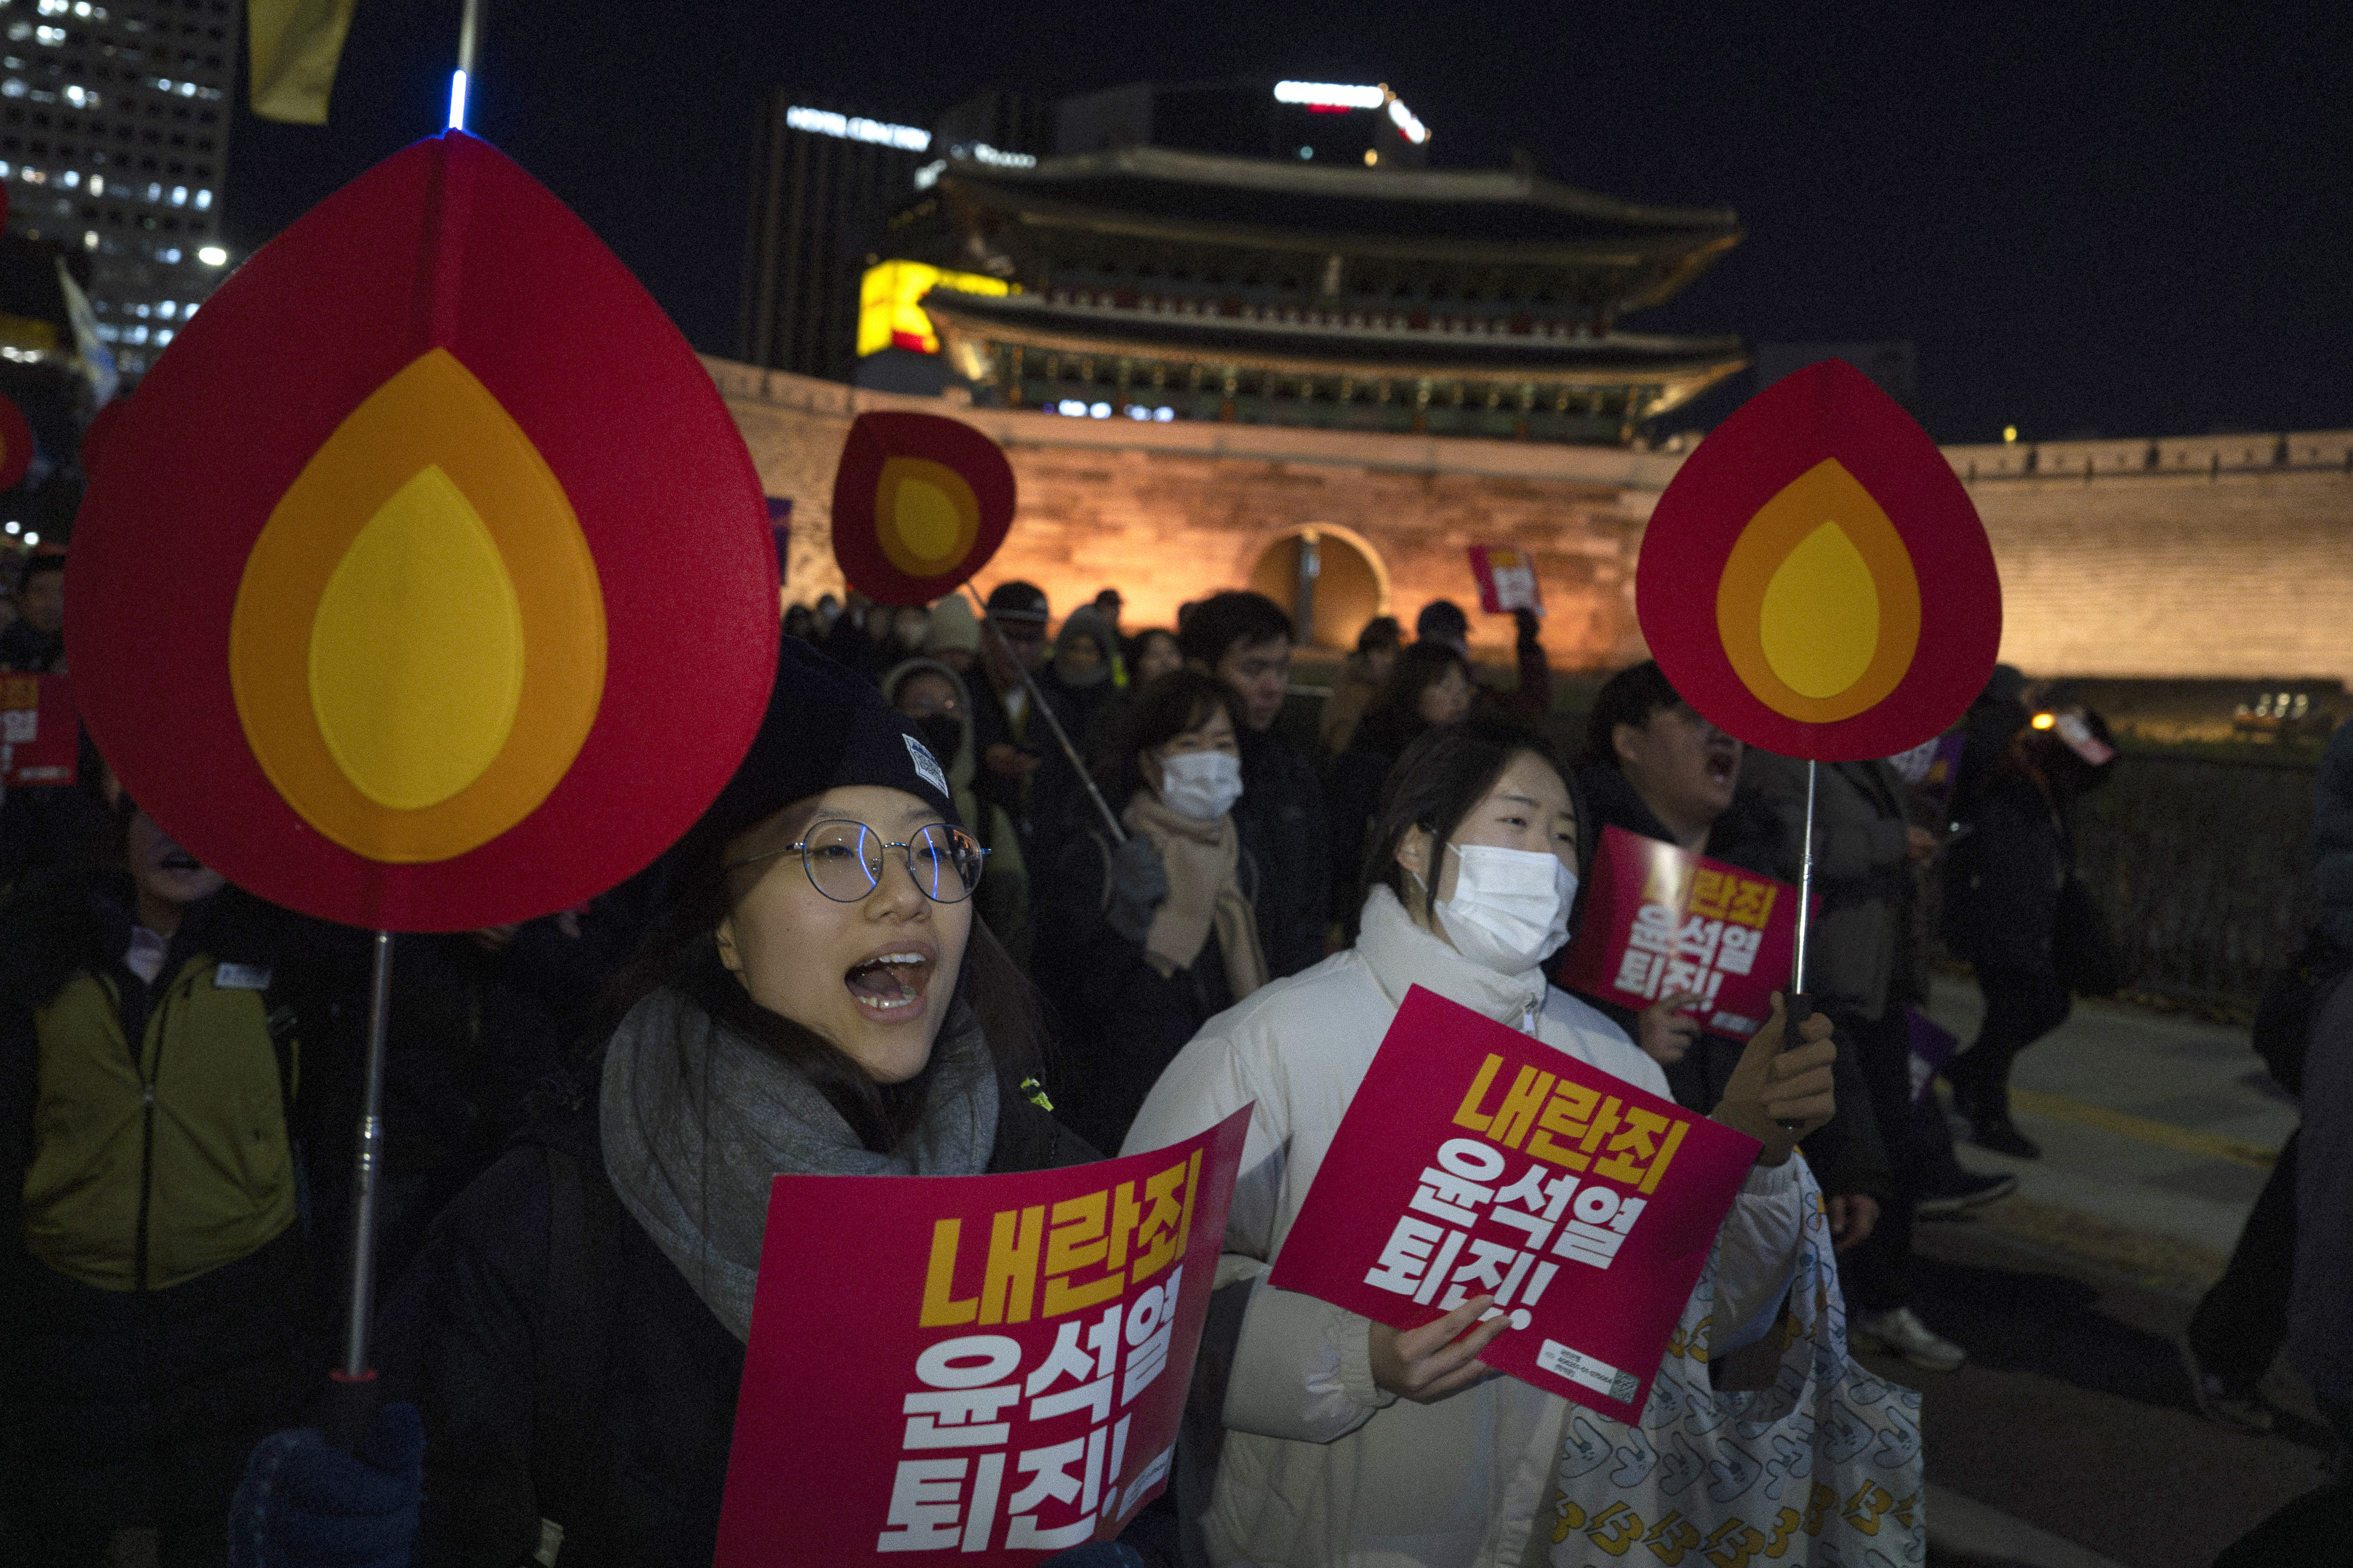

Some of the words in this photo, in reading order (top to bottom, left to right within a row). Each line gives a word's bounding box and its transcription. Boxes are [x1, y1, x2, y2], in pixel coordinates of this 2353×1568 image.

[1629, 904, 1763, 976] 윤석열
[1452, 1053, 1690, 1194] 내란죄
[919, 1148, 1203, 1327] 내란죄
[1363, 1215, 1559, 1330] 퇴진!
[1408, 1138, 1647, 1270] 윤석열
[902, 1264, 1183, 1449] 윤석열
[876, 1412, 1131, 1553] 퇴진!
